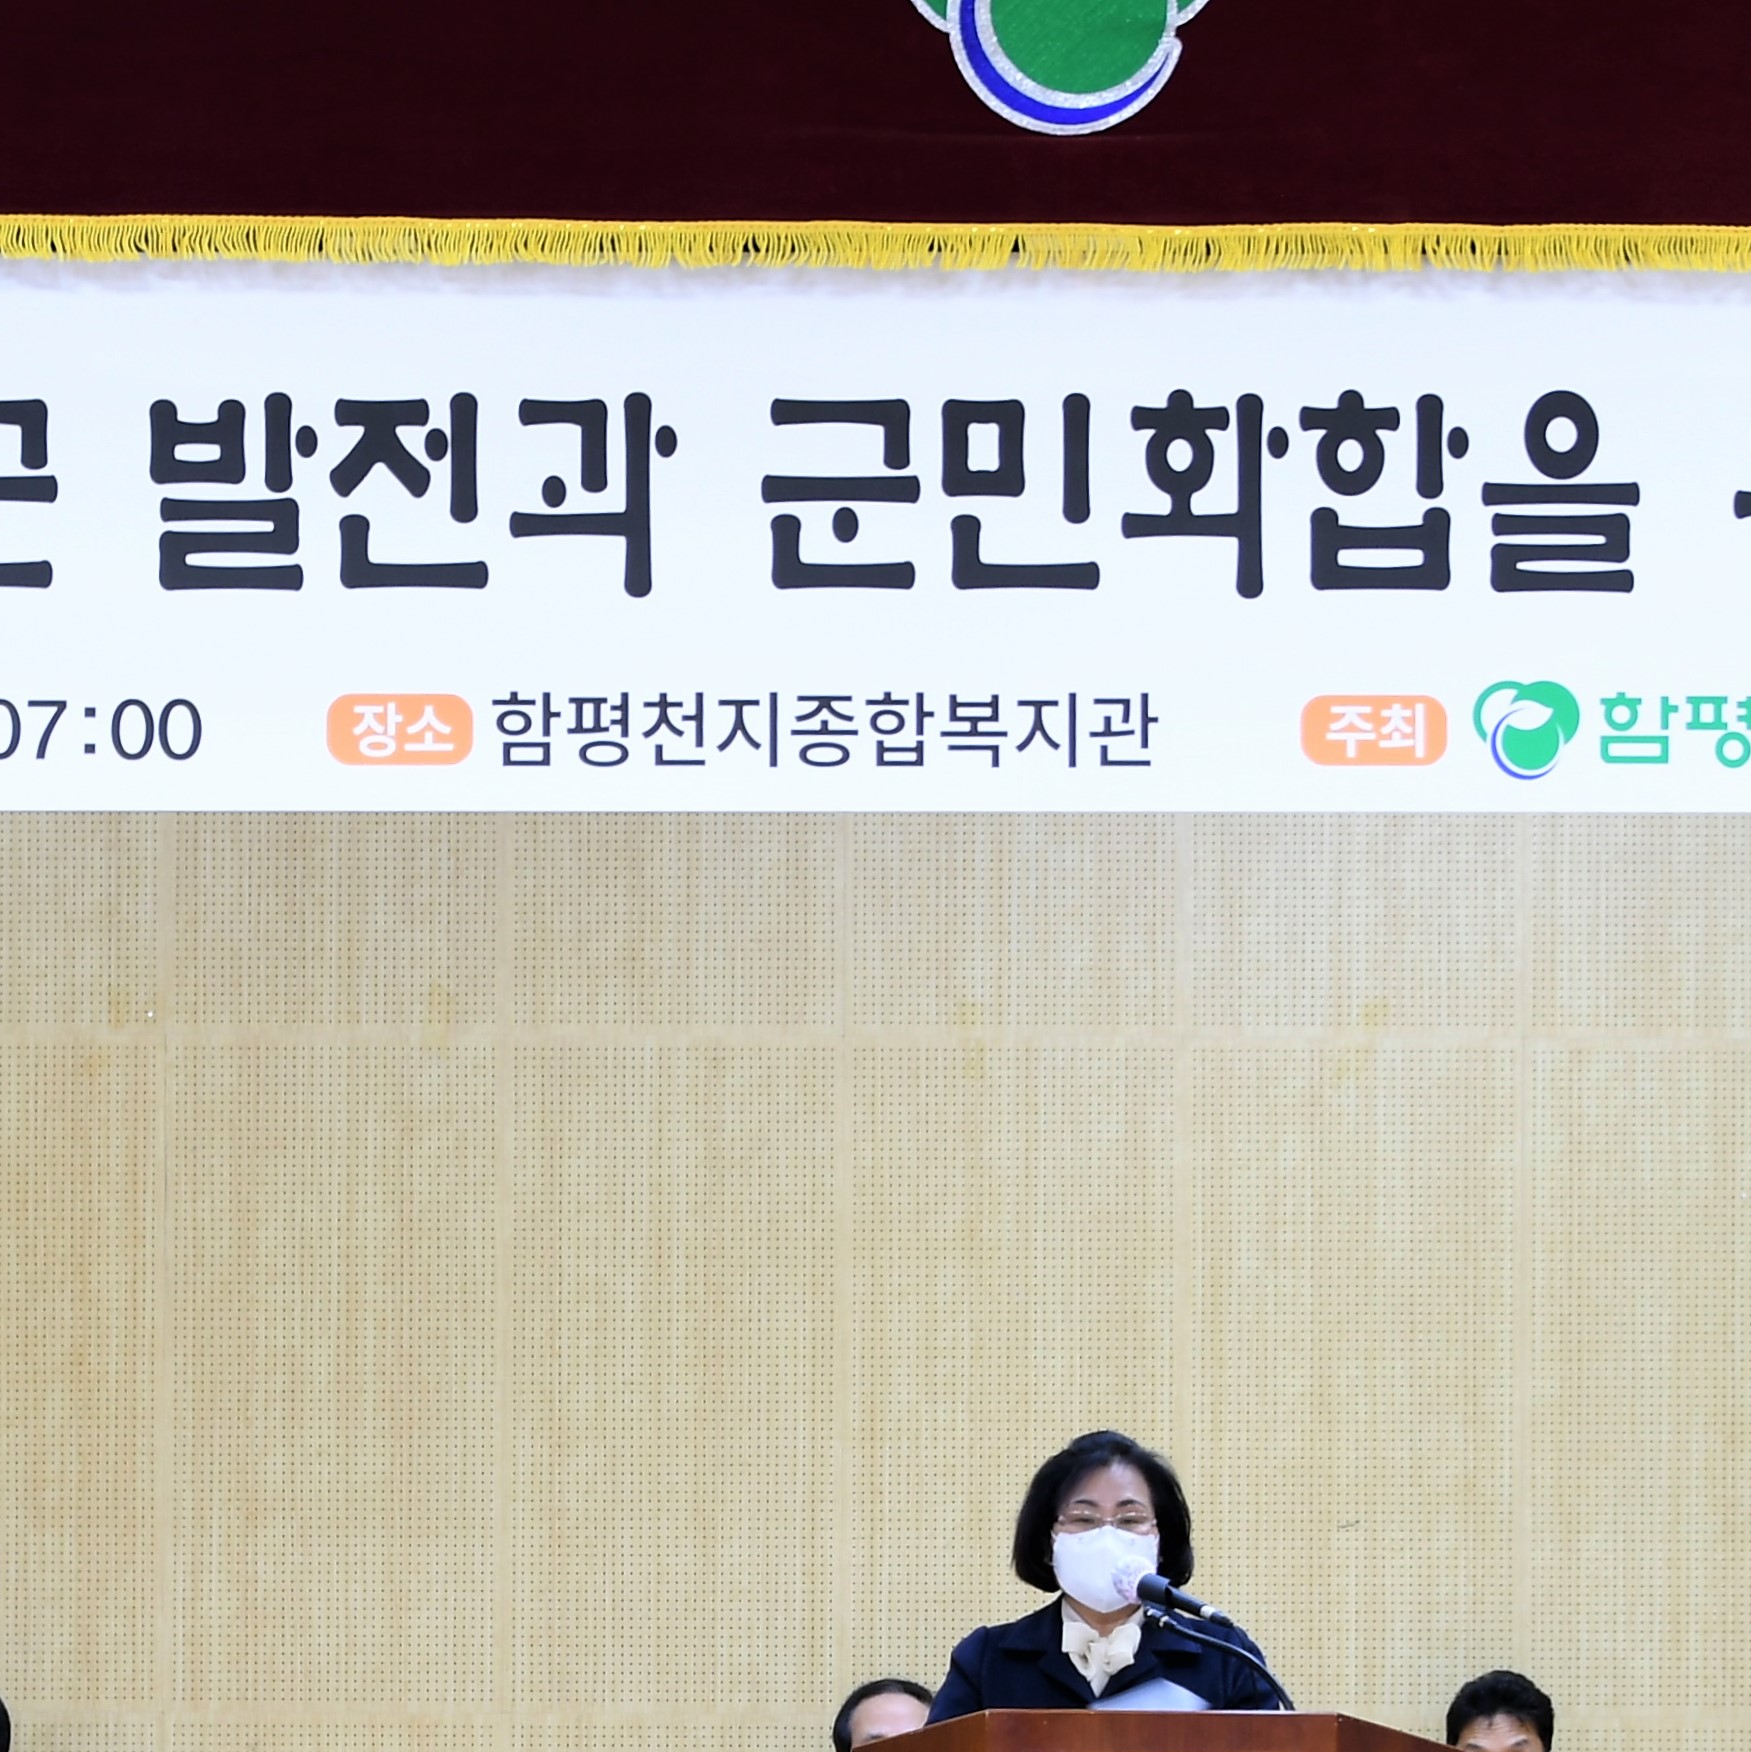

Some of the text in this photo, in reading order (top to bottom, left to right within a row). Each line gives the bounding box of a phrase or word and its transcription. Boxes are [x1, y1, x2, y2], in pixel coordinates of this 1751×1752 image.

[149, 391, 678, 599] 발전과
[760, 388, 1641, 600] 군민화합을
[351, 691, 1159, 768] 장소 함평천지종합복지관
[1324, 702, 1428, 760] 주최
